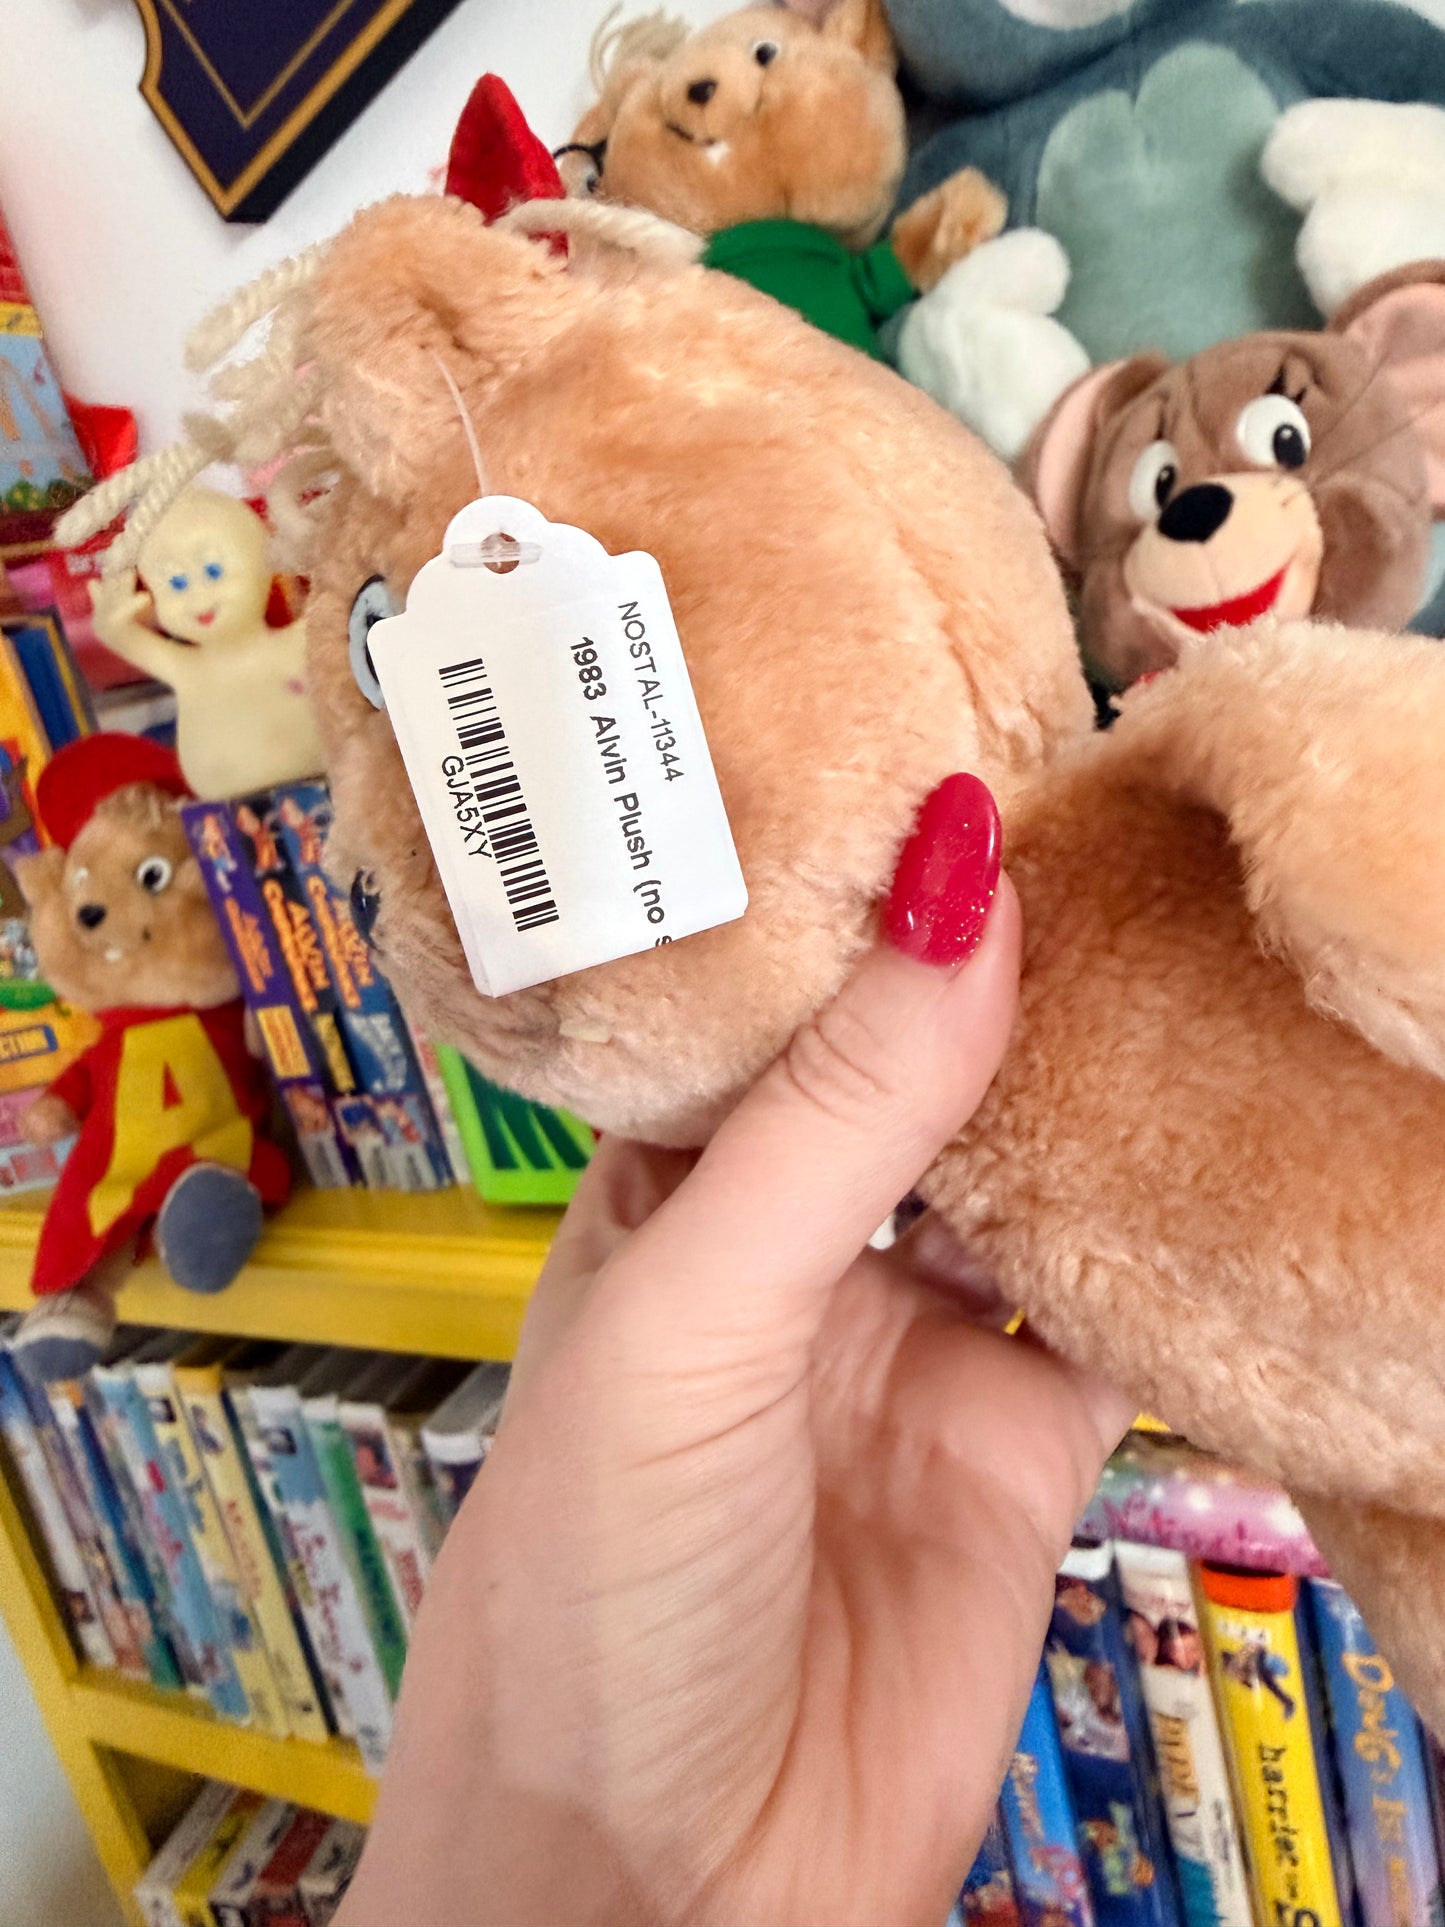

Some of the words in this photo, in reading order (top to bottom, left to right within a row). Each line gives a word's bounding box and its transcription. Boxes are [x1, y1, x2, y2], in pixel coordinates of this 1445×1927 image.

[570, 636, 607, 701] 1983
[589, 715, 627, 785] Alvin
[613, 792, 653, 871] Plush
[633, 880, 665, 924] (no
[617, 601, 685, 782] NOSTAL-11344
[441, 755, 493, 858] GJA5XY
